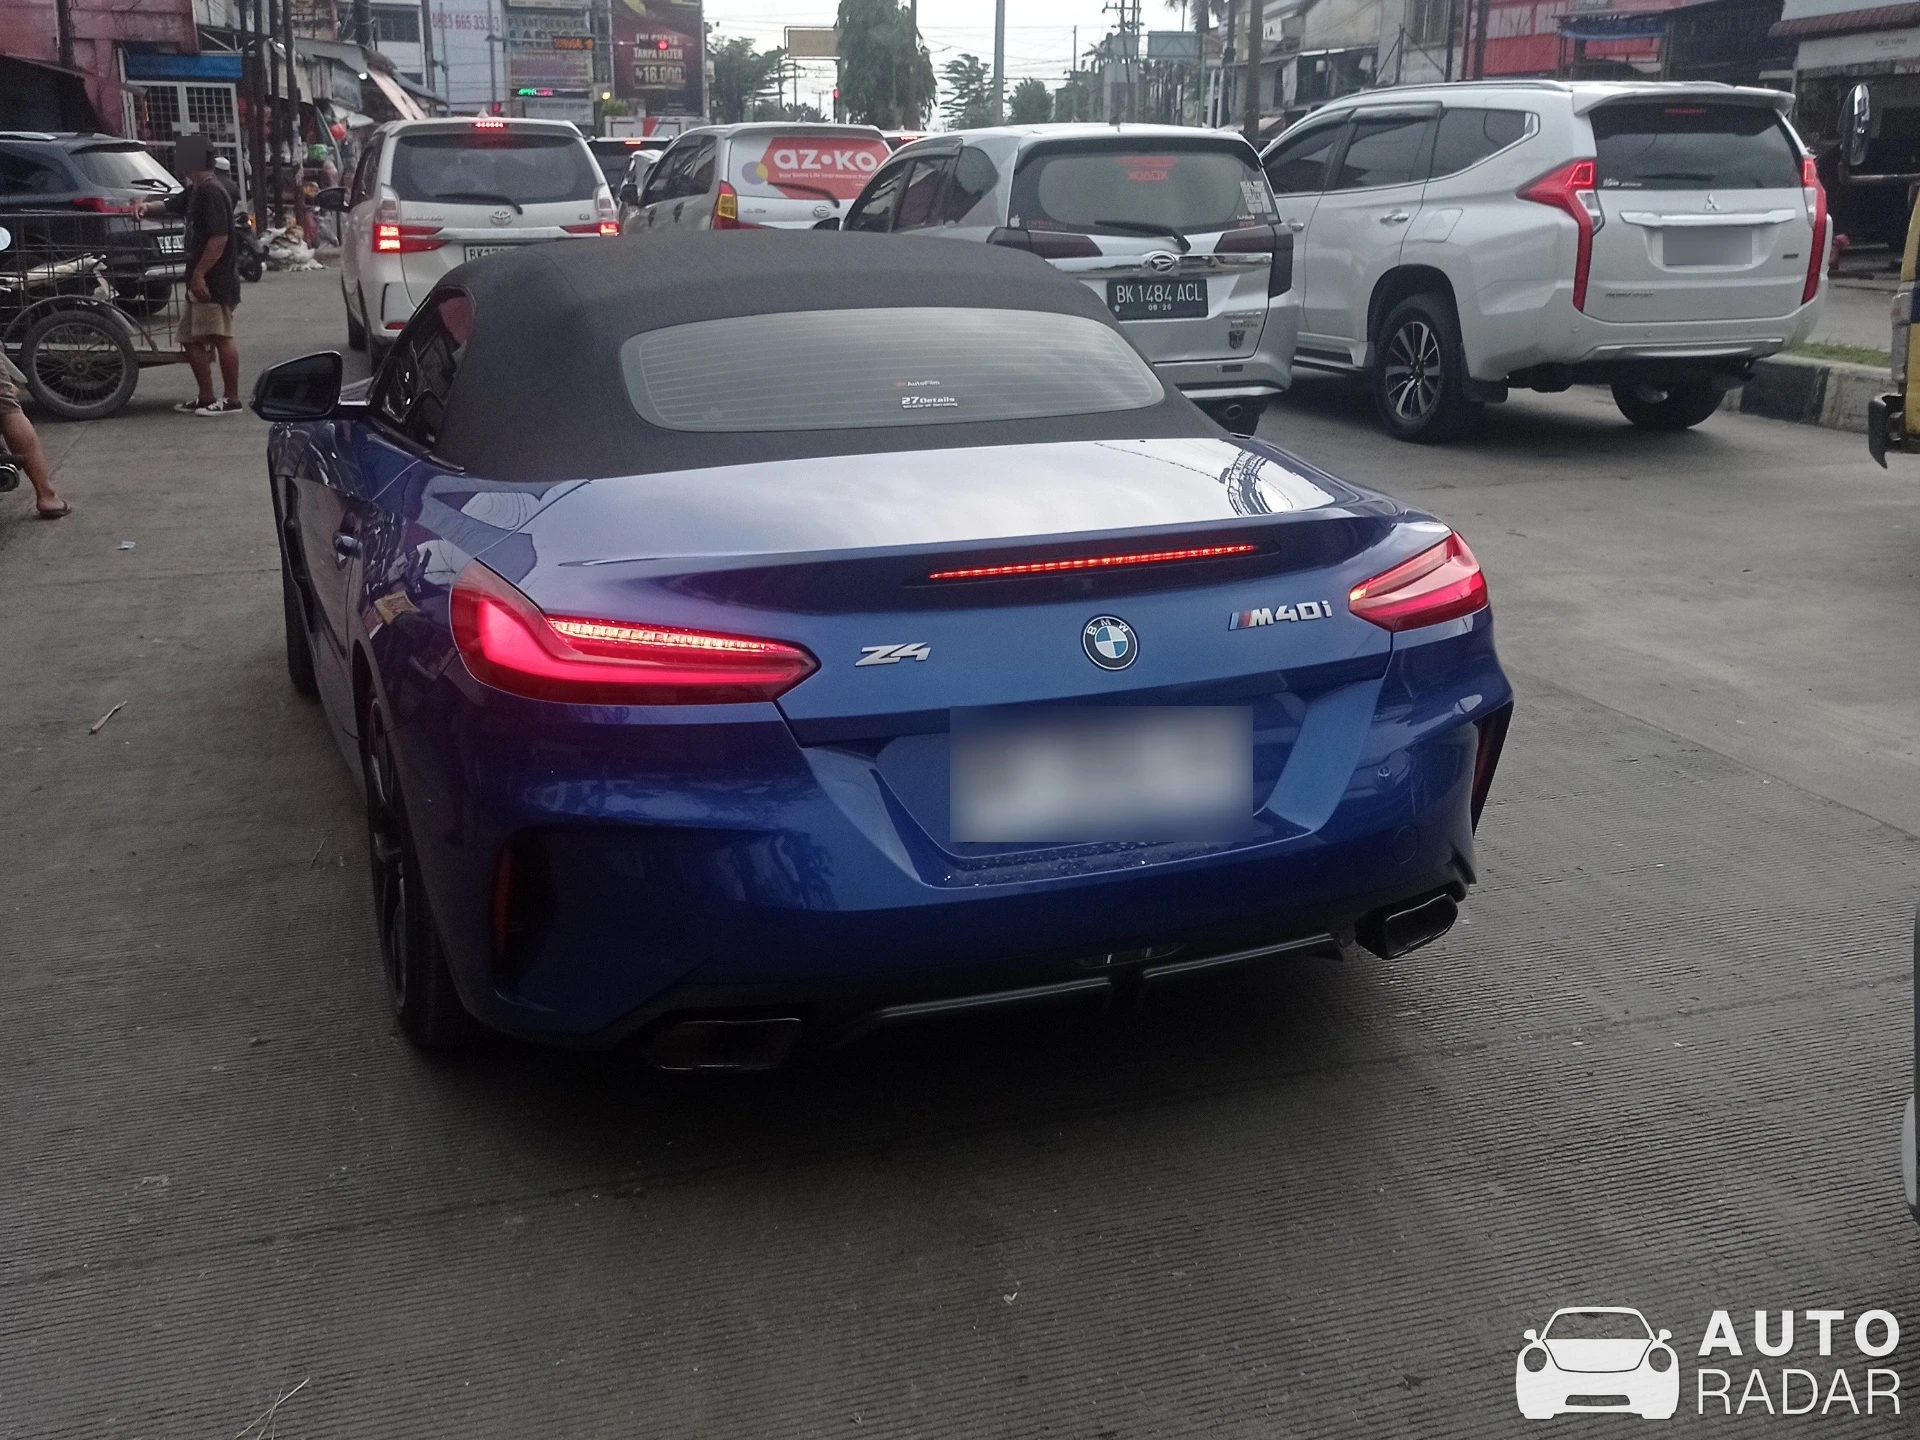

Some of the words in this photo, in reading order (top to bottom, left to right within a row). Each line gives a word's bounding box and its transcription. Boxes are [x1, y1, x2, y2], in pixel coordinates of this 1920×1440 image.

[658, 49, 683, 60] FILTER
[1116, 285, 1134, 304] BK
[1138, 284, 1172, 303] 1484
[1176, 282, 1203, 302] ACL
[1246, 600, 1334, 628] M40i
[1087, 618, 1130, 637] BMW
[855, 641, 931, 667] Z4
